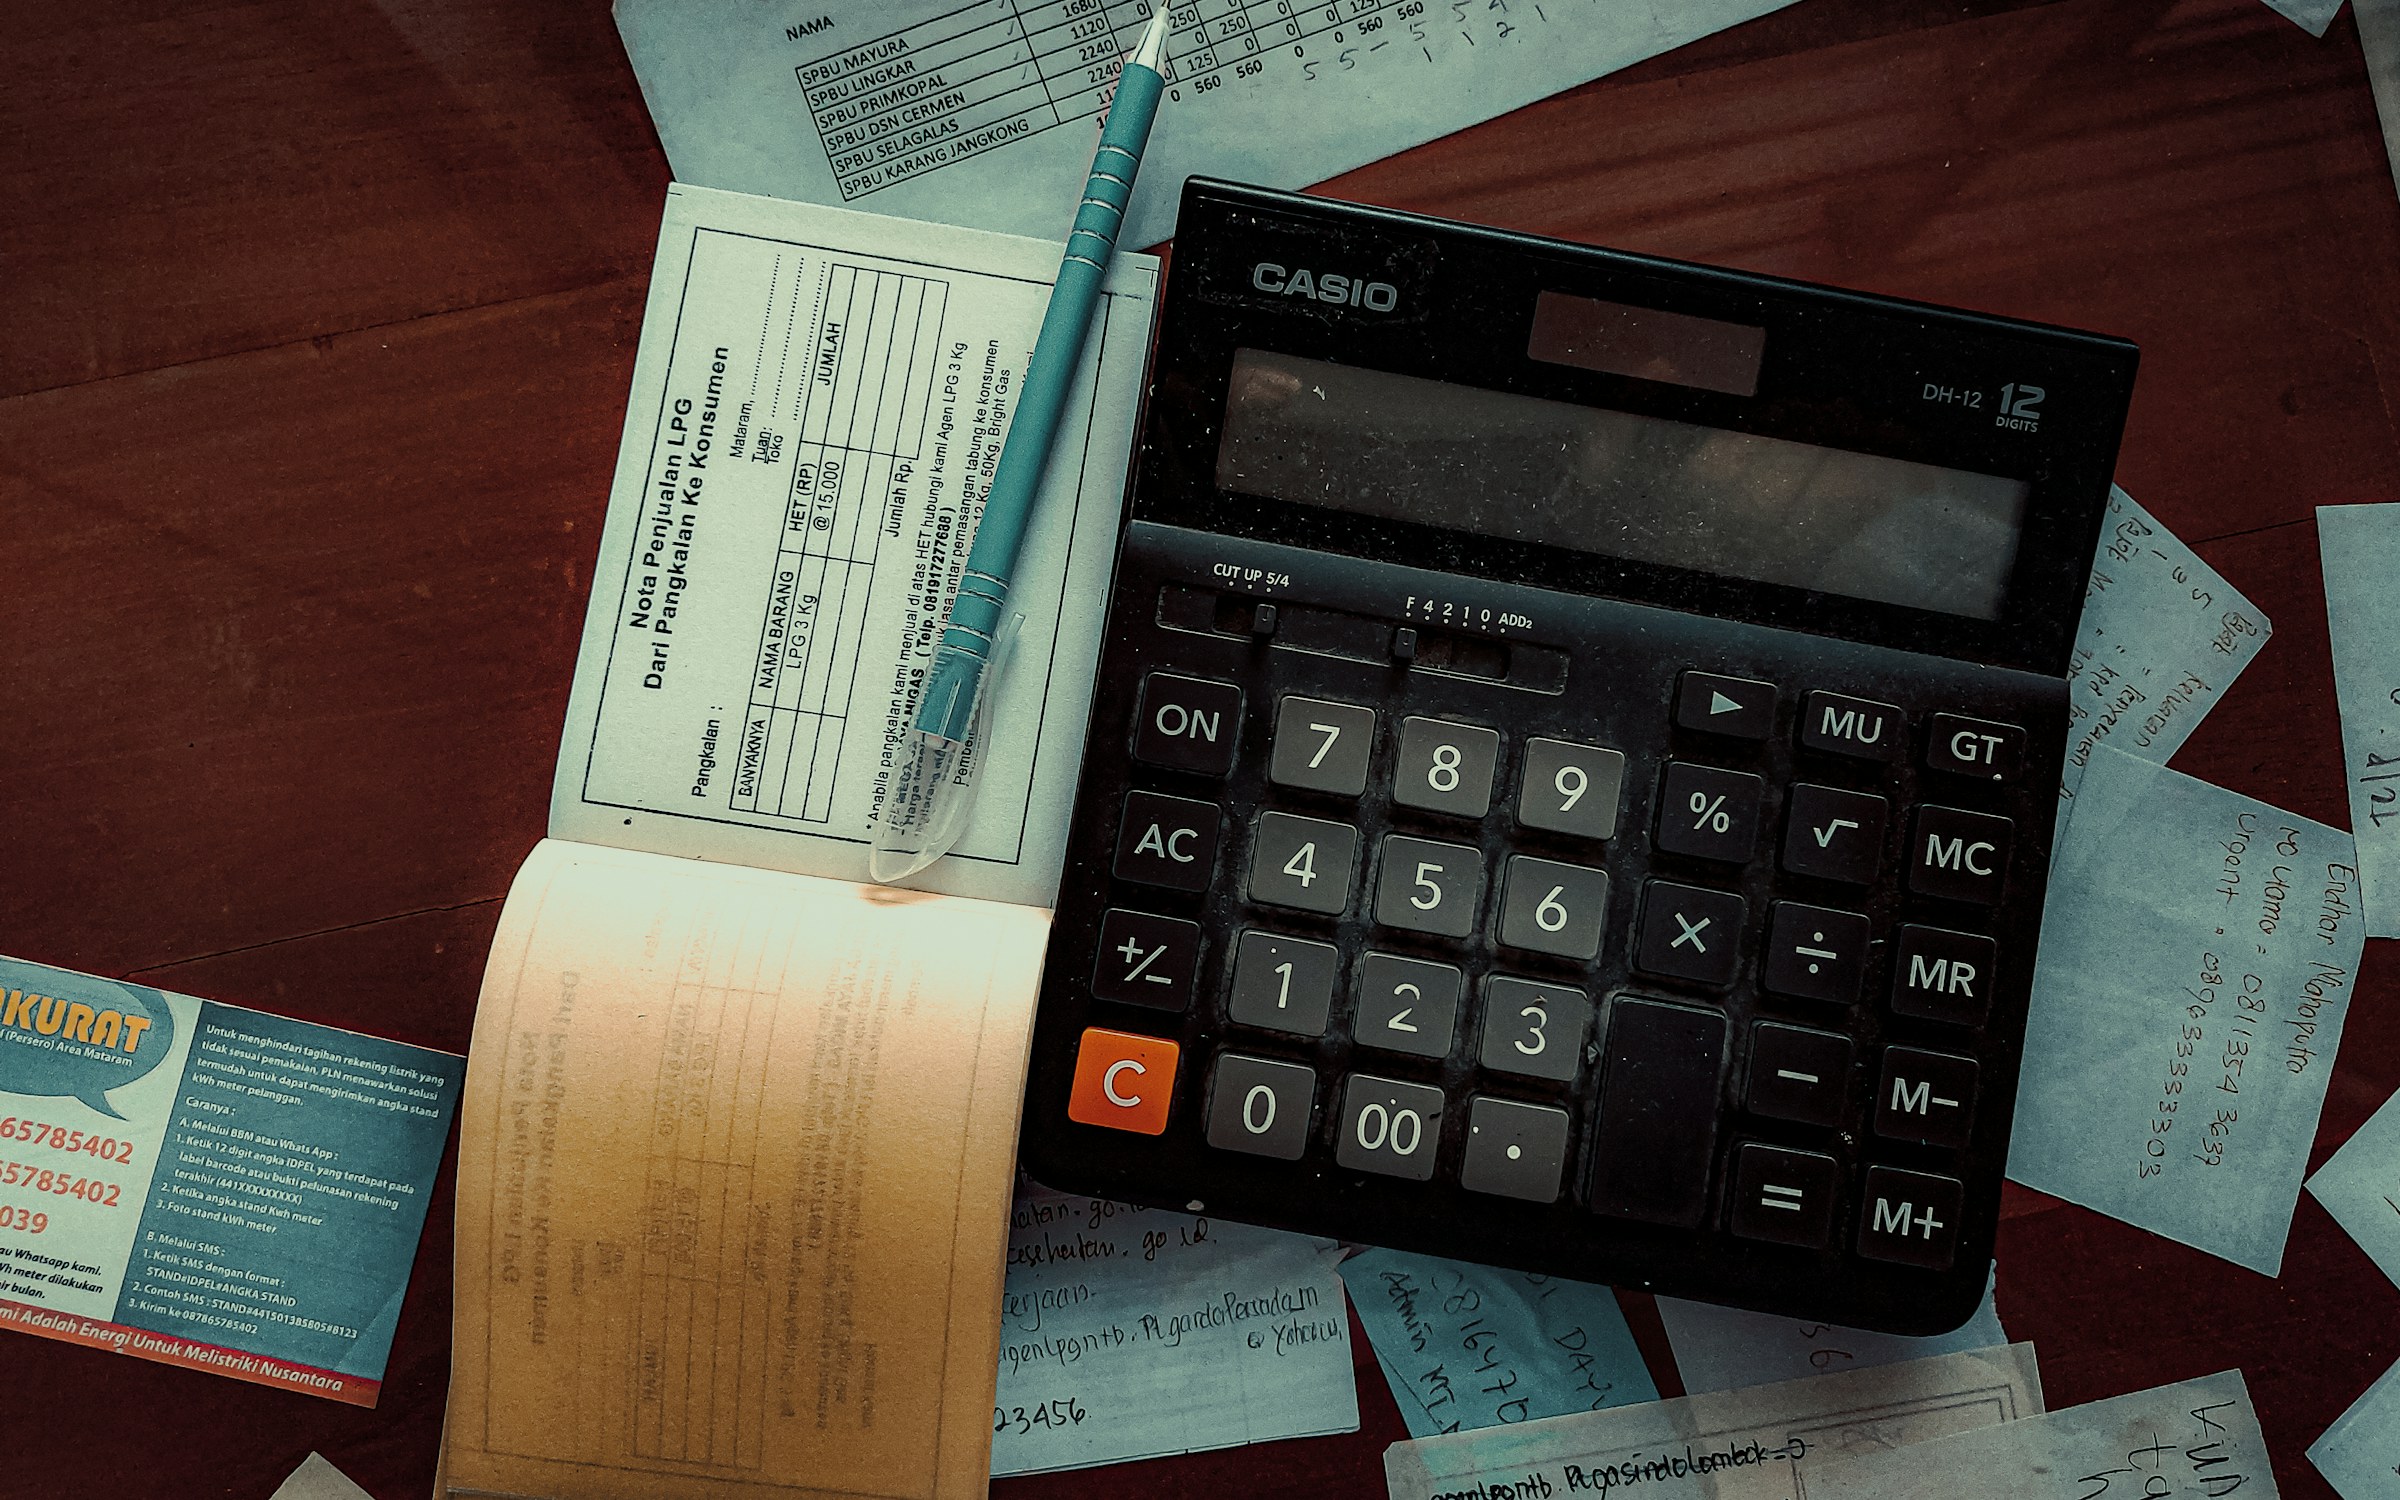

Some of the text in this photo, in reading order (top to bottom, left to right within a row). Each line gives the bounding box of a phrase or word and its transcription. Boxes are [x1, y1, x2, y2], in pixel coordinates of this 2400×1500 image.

[785, 15, 835, 42] NAMA
[1070, 18, 1105, 40] 1120
[1078, 40, 1114, 62] 2240
[1087, 16, 1246, 84] 2240 250
[1194, 1, 1424, 94] 560 560 560 560
[802, 38, 909, 84] SPBU MAYURA
[810, 60, 916, 106] SPBU LINGKAR
[1187, 53, 1214, 73] 125
[818, 74, 947, 128] SPBU PRIMKOPAL
[827, 90, 965, 150] SPBU DSN CERMEN
[835, 118, 959, 172] SPBU SELAGALAS
[843, 118, 1029, 194] SPBU KARANG JANGKONG
[1253, 262, 1398, 312] CASIO
[980, 369, 1010, 479] 50Kg, Bright Gas
[1923, 383, 2046, 419] DH-12 12
[1996, 416, 2038, 432] DIGITS
[729, 400, 755, 458] Mataram,
[765, 435, 783, 464] Toko
[946, 339, 998, 594] antar pemasangan tabung ke konsumen
[628, 398, 692, 628] Nota Penjualan LPG
[642, 347, 729, 689] Dari Pangkalan Ke Konsumen
[884, 460, 914, 537] Jumlah Rp.
[737, 322, 841, 796] BANYAKNYA NAMA BARANG HET (RP) JUMLAH
[785, 461, 840, 669] LPG 3 Kg 15.000
[880, 342, 968, 767] pangkalan kami menjual di atas HET hubungi kami Agen LPG 3 Kg
[1214, 563, 1290, 588] CUT UP 5/4
[915, 616, 935, 647] Telp.
[1406, 596, 1416, 609] F
[1423, 600, 1434, 613] 4
[1443, 604, 1453, 616] 2
[1464, 606, 1470, 619] 1
[1481, 609, 1490, 622] 0
[1156, 704, 1220, 742] ON
[1820, 706, 2003, 765] MU GT
[691, 719, 720, 797] Pangkalan
[1307, 723, 1588, 812] 7 8 9
[1134, 823, 1199, 863] AC
[1689, 792, 1995, 875] % MC
[1283, 842, 1568, 932] 4 5 6
[1909, 955, 1975, 998] MR
[1275, 962, 1547, 1055] 1 2 3
[5, 1030, 132, 1066] (Persero) Area Mataram
[206, 1024, 444, 1087] Untuk menghindari yang
[192, 1072, 247, 1092] kWh meter
[247, 1070, 438, 1118] untuk angka stand
[320, 1066, 341, 1079] PLN
[1103, 1059, 1147, 1107] C
[185, 1096, 229, 1114] Caranya
[1243, 1084, 1422, 1155] 0 00
[0, 1117, 134, 1164] 65785402
[254, 1135, 332, 1160] atau Whats App
[253, 1152, 414, 1194] angka yang pada
[205, 1194, 236, 1206] angka
[1873, 1197, 1943, 1240] M+
[14, 1248, 101, 1276] Whatsapp kami.
[181, 1256, 203, 1269] SMS
[197, 1242, 220, 1255] SMS
[10, 1282, 45, 1298] bulan.
[13, 1268, 103, 1293] meter dilakukan
[260, 1291, 296, 1306] STAND
[19, 1310, 343, 1391] Adalah Energi Untuk Melistriki Nusantara
